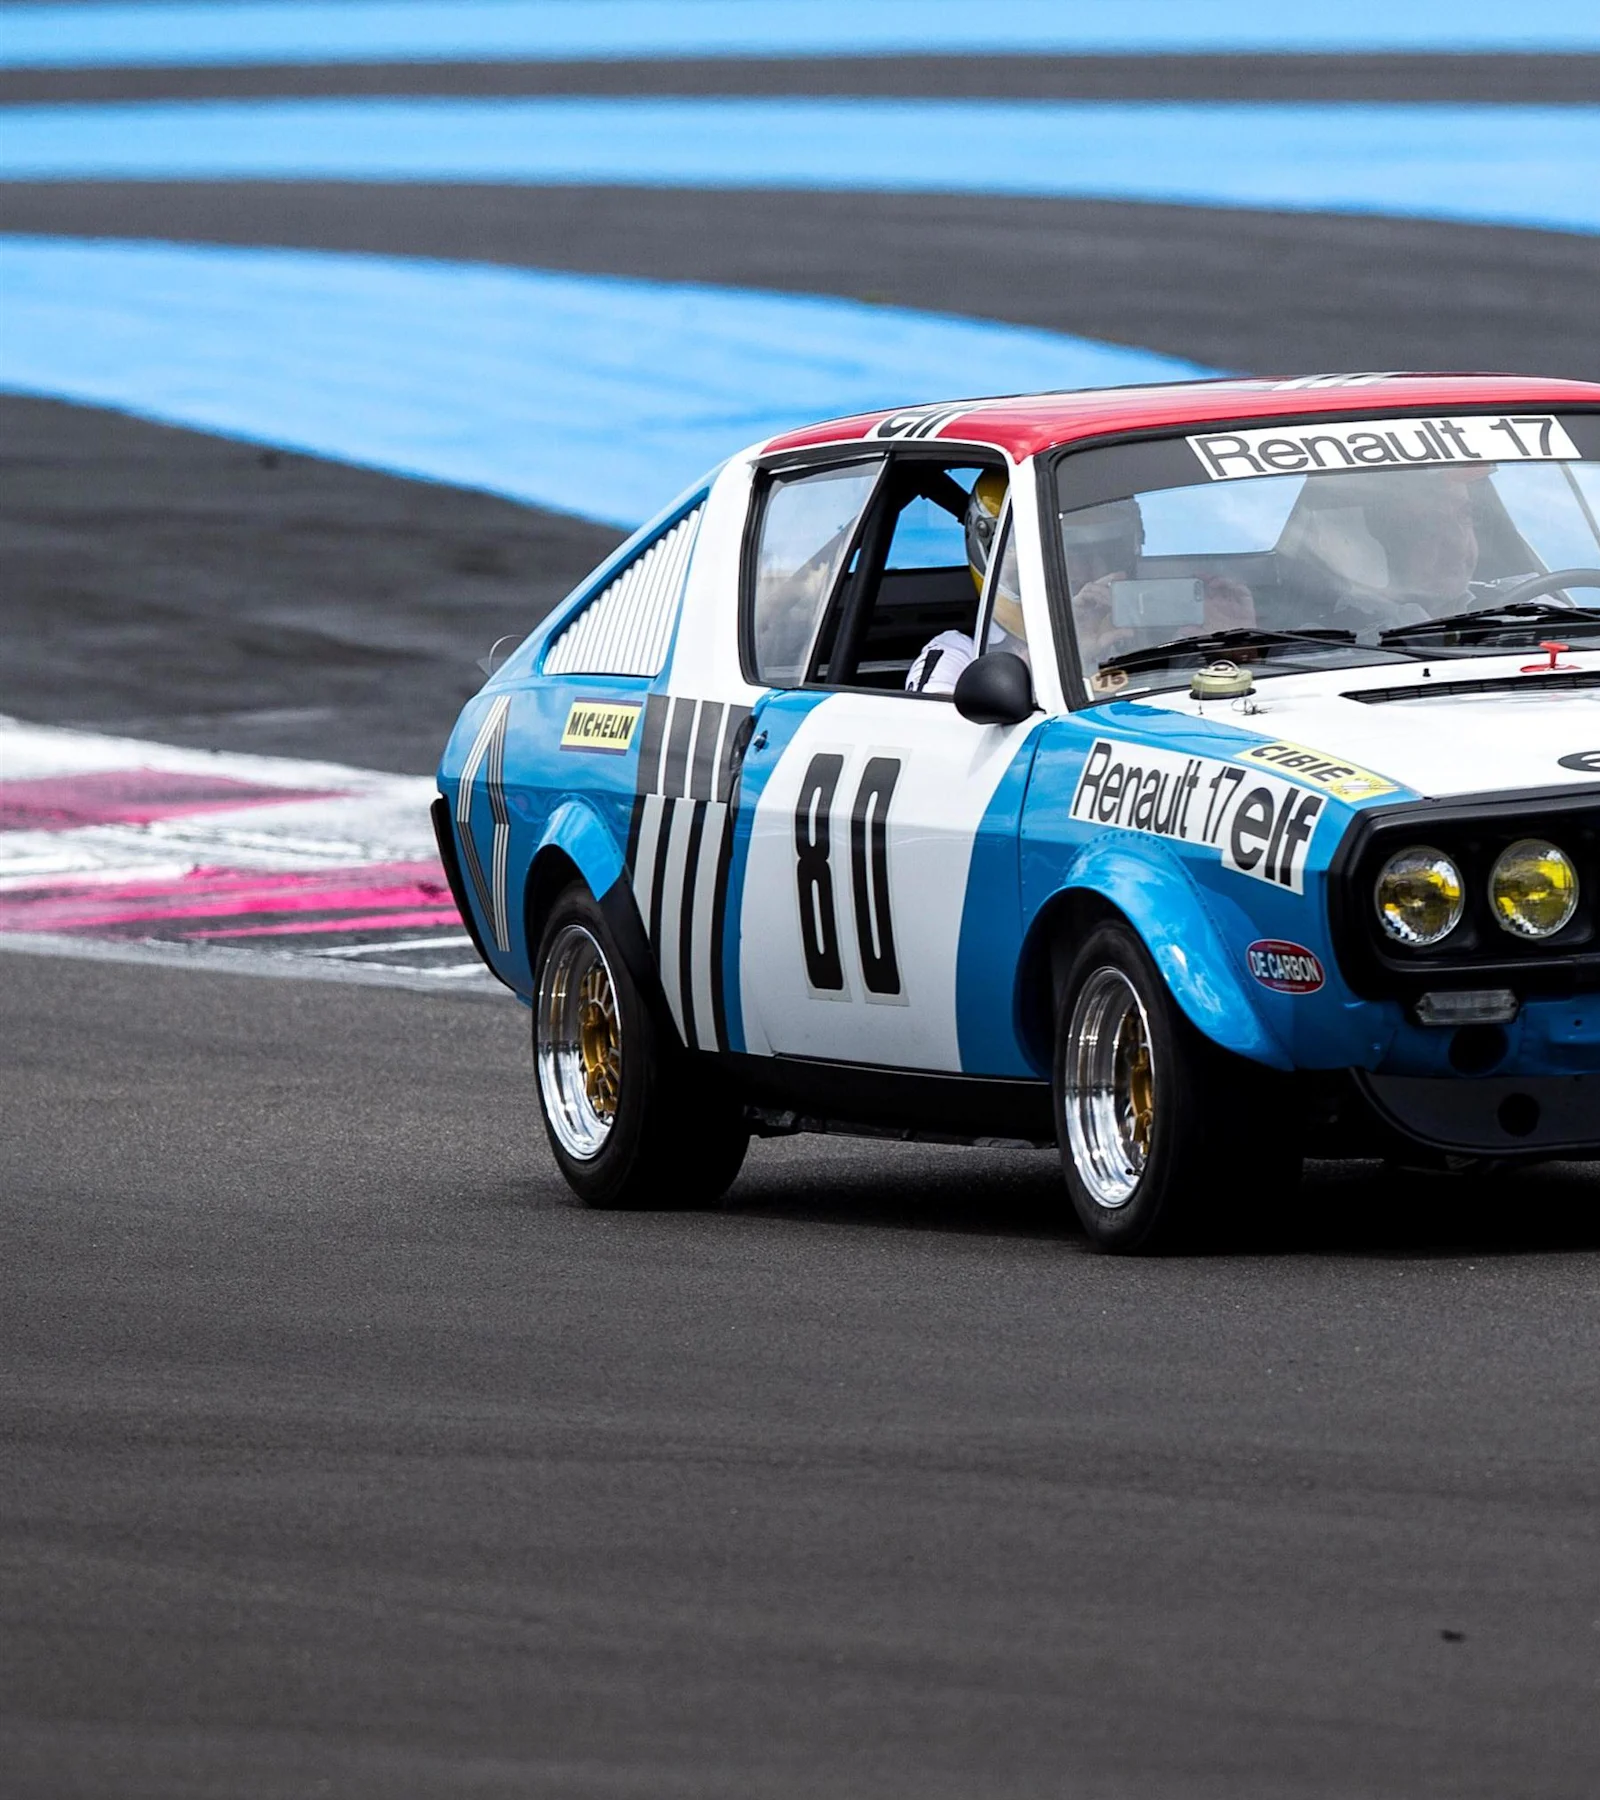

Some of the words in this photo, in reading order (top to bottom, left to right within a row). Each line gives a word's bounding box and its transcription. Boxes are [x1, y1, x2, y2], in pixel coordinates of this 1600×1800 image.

[1195, 420, 1481, 476] Renault
[1489, 418, 1553, 456] 17
[567, 711, 634, 740] MICHELIN
[1072, 742, 1202, 838] Renault
[1202, 766, 1246, 843] 17
[1251, 745, 1356, 782] CIBIE
[1231, 787, 1323, 886] elf
[794, 753, 901, 995] 80
[1249, 950, 1269, 977] DE
[1267, 952, 1320, 982] CARBON
